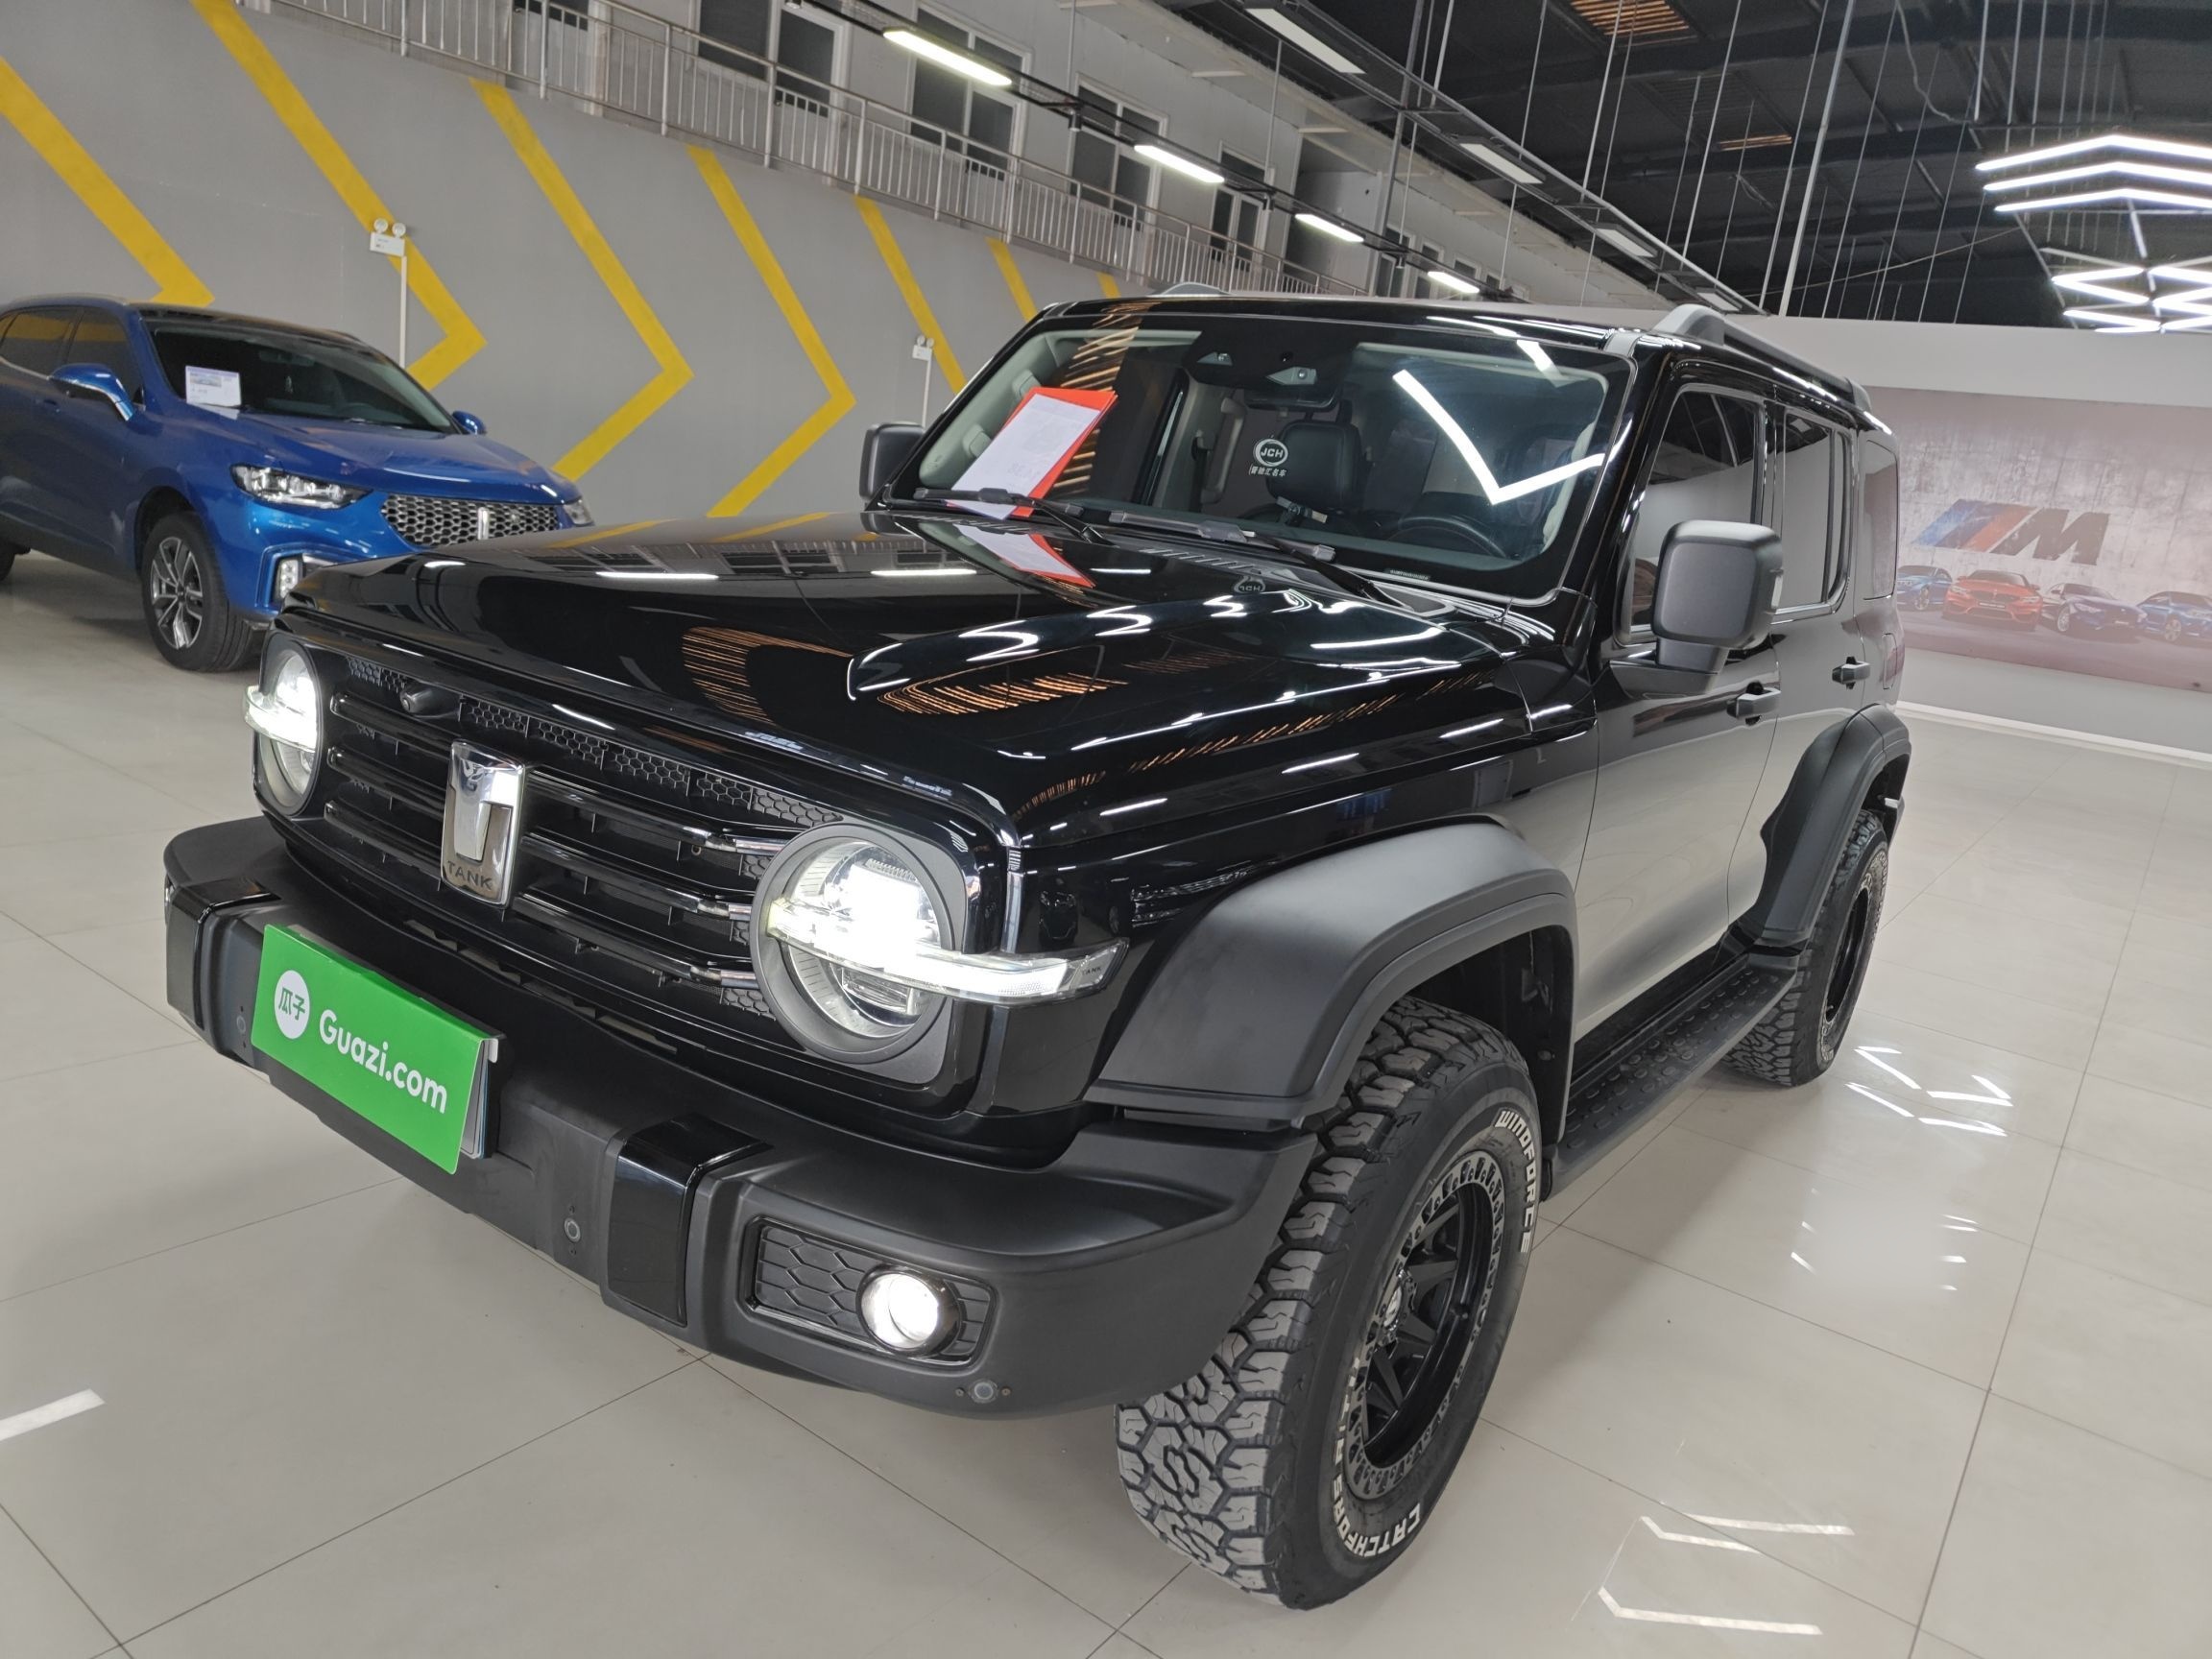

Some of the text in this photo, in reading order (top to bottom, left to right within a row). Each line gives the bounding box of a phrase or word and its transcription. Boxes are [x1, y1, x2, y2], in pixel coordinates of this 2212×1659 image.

[1261, 447, 1284, 458] JCH
[1989, 507, 2111, 566] M
[447, 860, 493, 890] TANK
[277, 987, 306, 1021] 瓜子
[319, 1009, 447, 1114] Guazi.com
[1494, 1110, 1536, 1253] WINDFORCE
[1333, 1473, 1421, 1557] CATCHFORS
